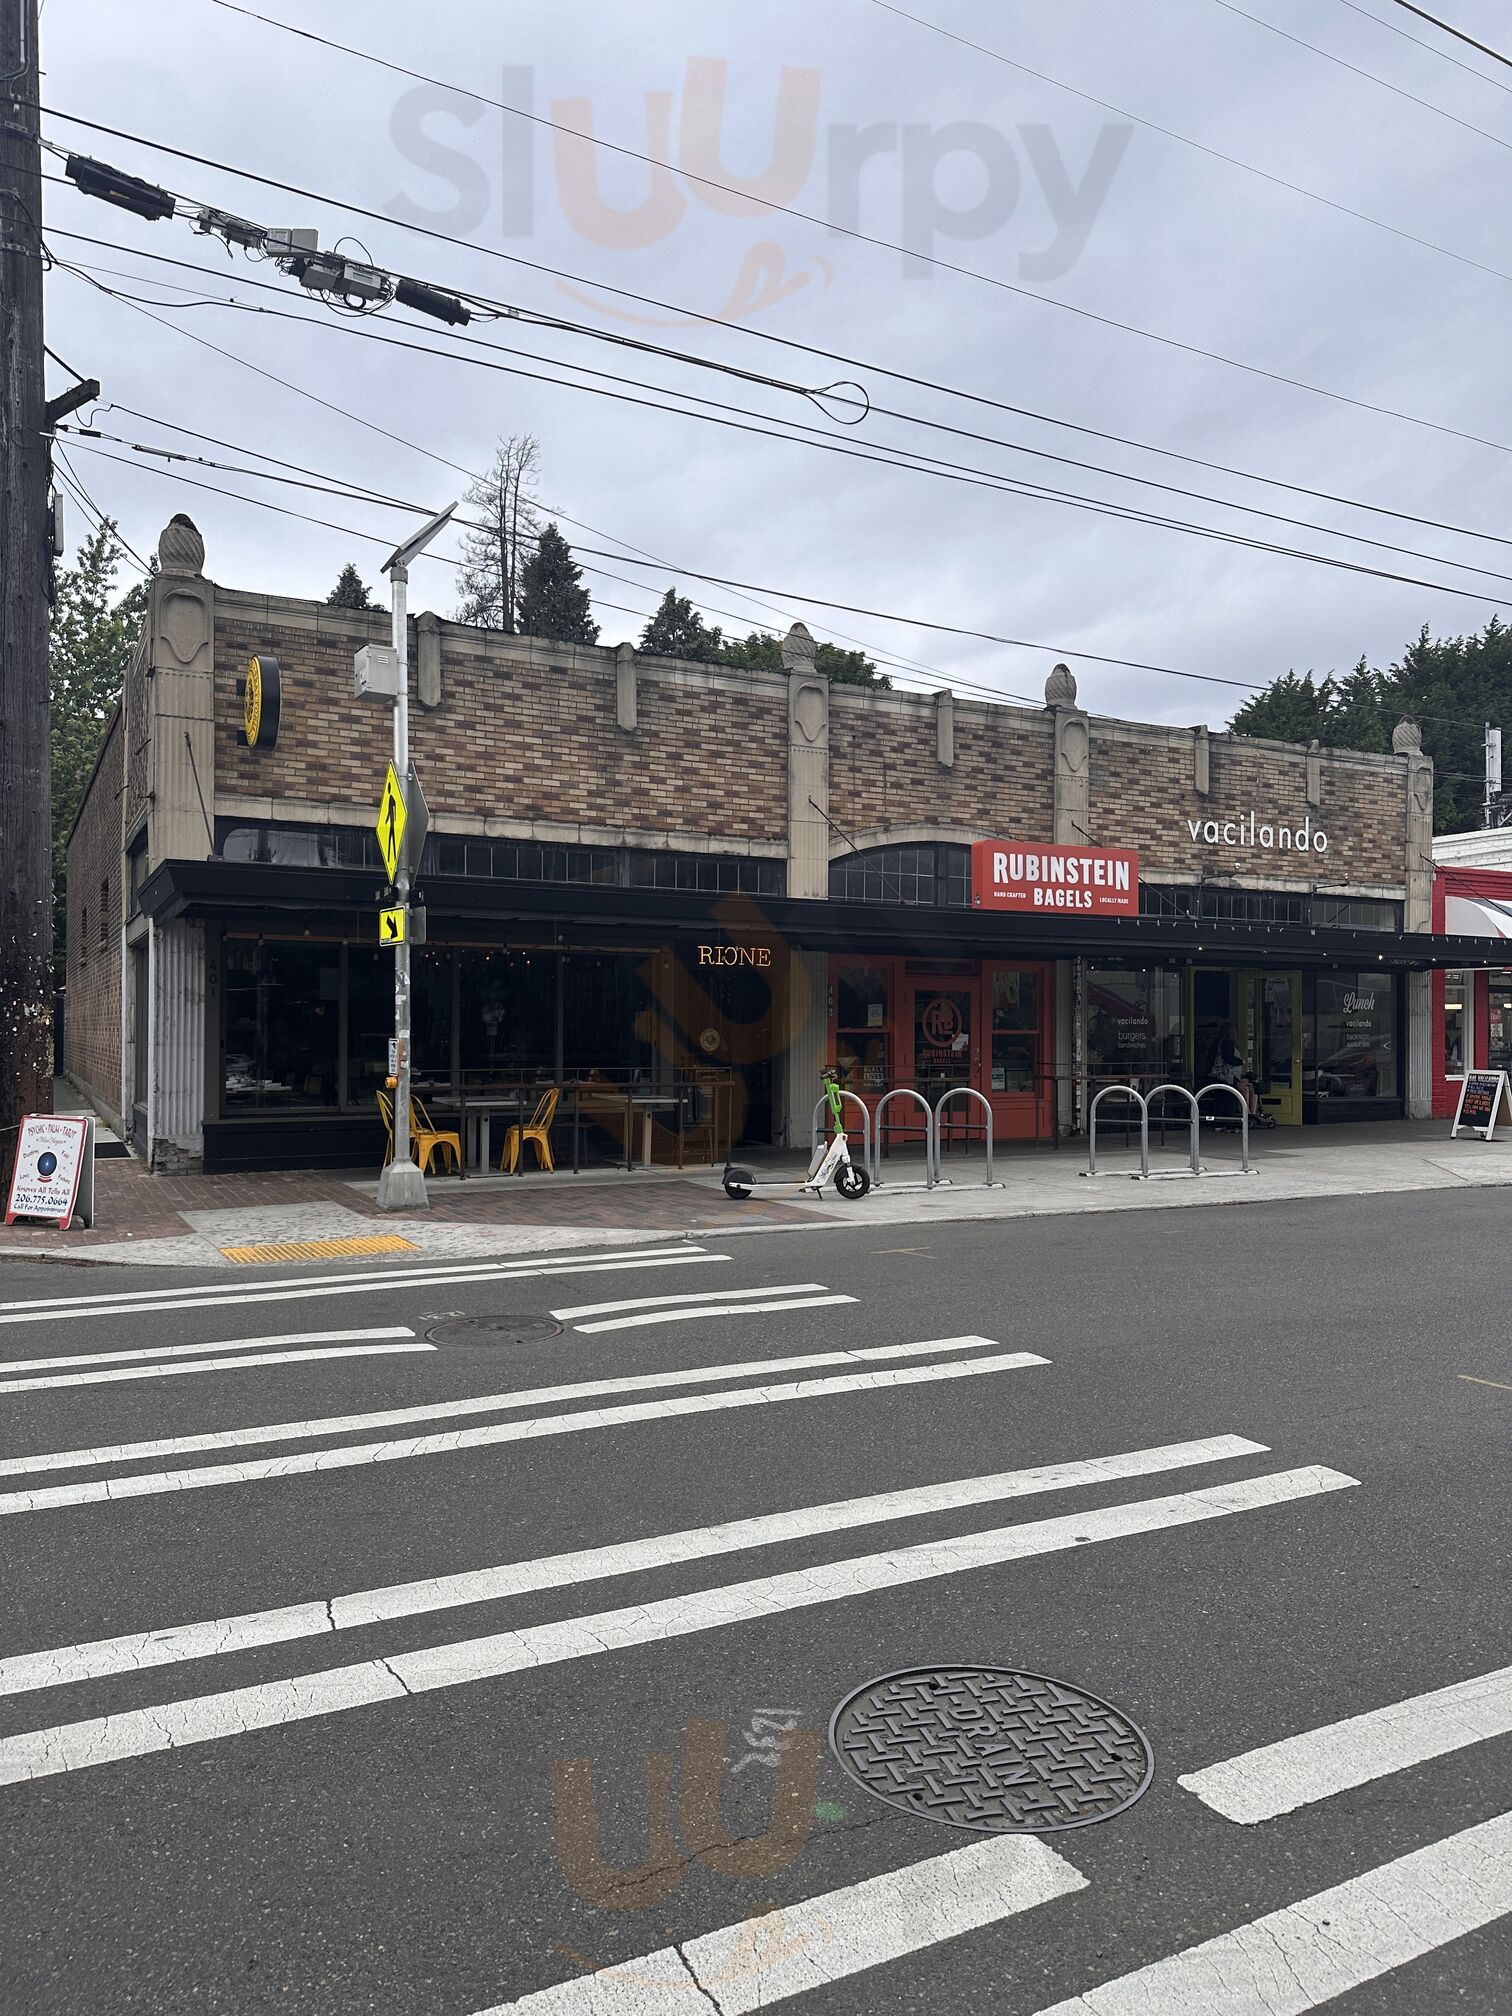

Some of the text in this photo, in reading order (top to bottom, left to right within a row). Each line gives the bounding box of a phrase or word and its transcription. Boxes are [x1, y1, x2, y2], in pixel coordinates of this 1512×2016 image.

[1187, 811, 1328, 853] vacilando
[993, 852, 1129, 891] RUBINSTEIN
[1033, 888, 1093, 908] BAGELS
[697, 945, 771, 967] RIONE
[1342, 991, 1375, 1013] Lunch
[1117, 1016, 1149, 1025] vacilando
[1117, 1030, 1147, 1042] burgers
[15, 1194, 67, 1205] 206.775.0664
[16, 1185, 36, 1193] Knows
[48, 1187, 60, 1195] Tells
[33, 1205, 66, 1214] Appointment
[948, 1706, 1039, 1787] DRAIN
